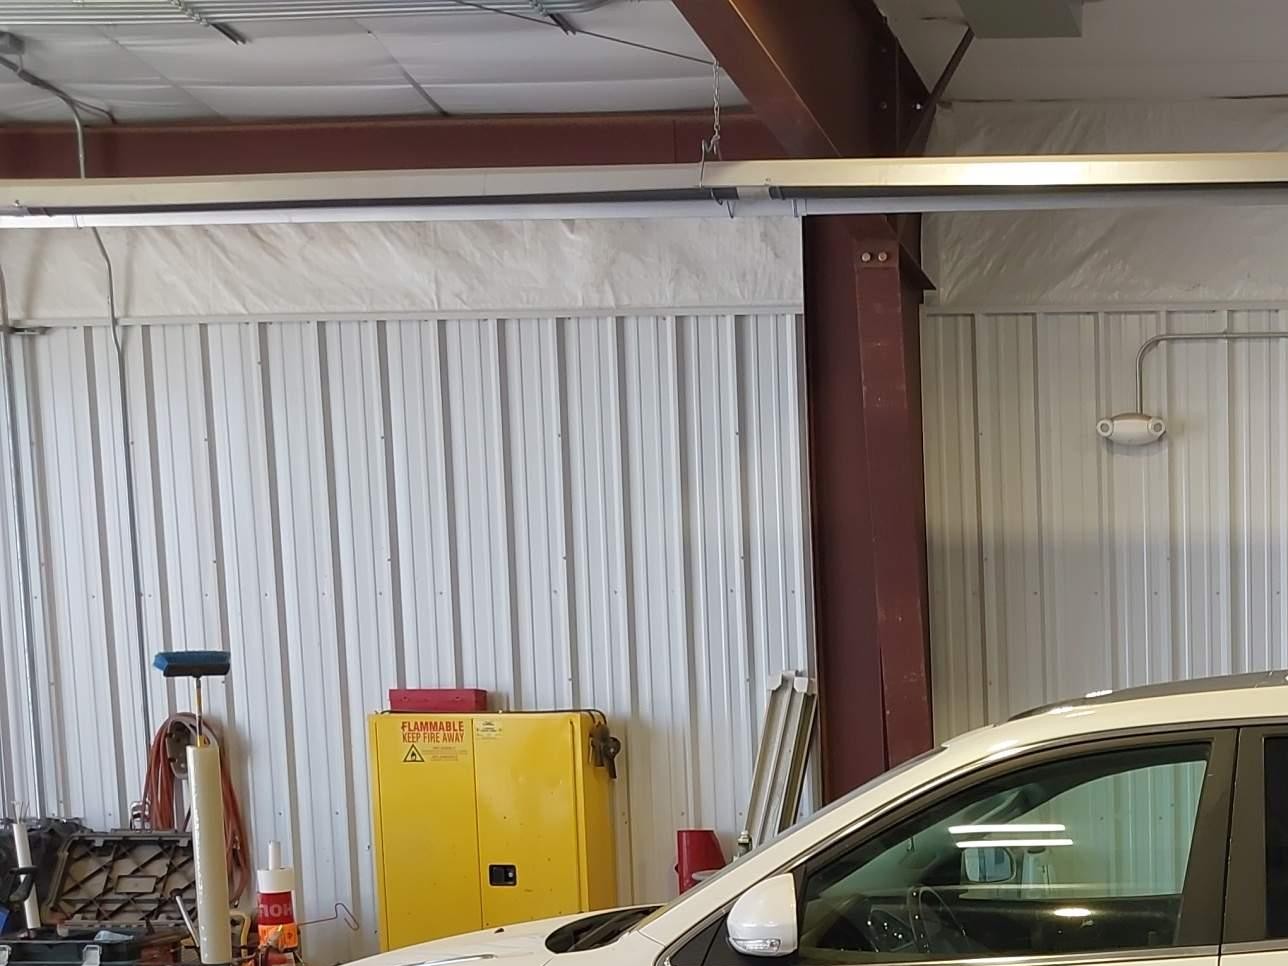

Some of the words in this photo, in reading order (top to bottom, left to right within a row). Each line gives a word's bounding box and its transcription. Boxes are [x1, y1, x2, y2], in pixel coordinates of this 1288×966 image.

[401, 721, 465, 732] FLAMMABLE
[402, 732, 421, 743] KEEP
[423, 732, 440, 743] FIRE
[442, 732, 465, 743] AWAY
